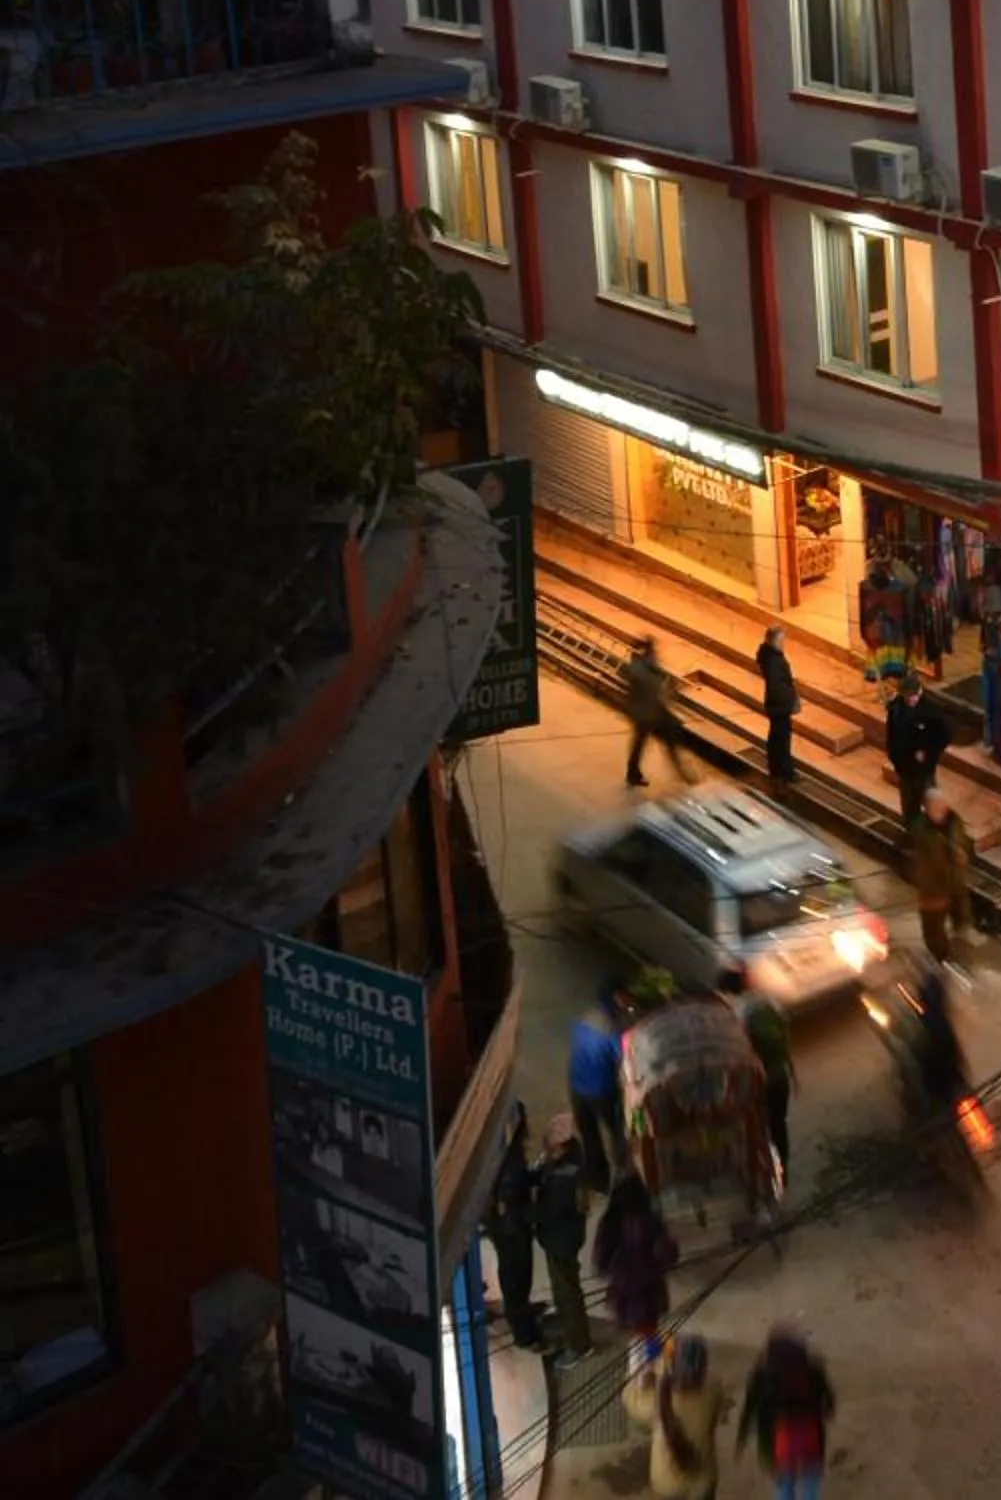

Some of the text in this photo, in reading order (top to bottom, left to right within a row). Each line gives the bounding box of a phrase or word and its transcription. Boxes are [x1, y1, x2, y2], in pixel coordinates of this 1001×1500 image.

[263, 939, 417, 1028] Karma
[267, 1003, 328, 1050] Home
[284, 987, 396, 1046] Travellers
